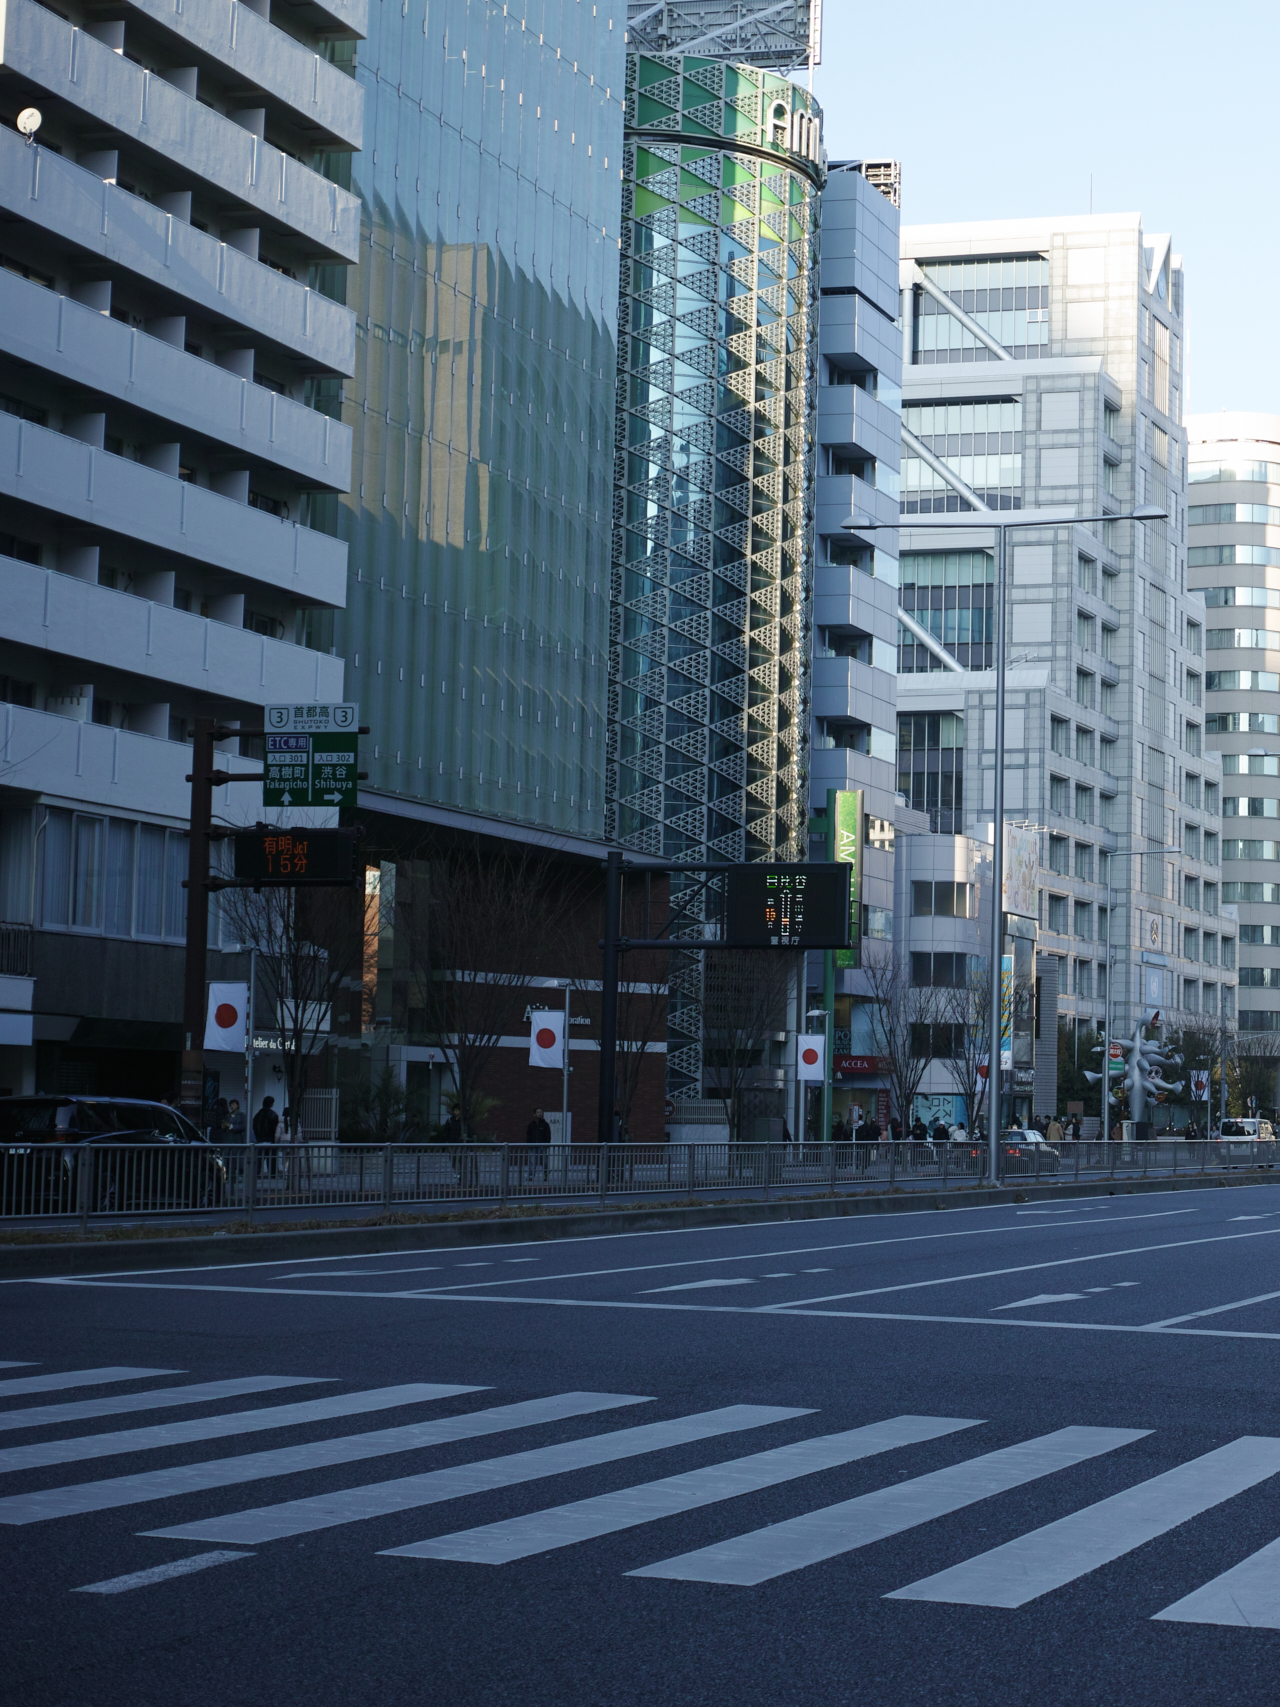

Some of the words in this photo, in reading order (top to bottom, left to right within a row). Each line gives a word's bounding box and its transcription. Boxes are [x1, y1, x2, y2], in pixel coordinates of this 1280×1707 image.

[276, 711, 283, 723] 3
[293, 706, 330, 718] 首都高
[340, 710, 348, 722] 3
[268, 737, 307, 749] ETC専用
[271, 755, 286, 763] 入口
[289, 755, 304, 763] 301
[318, 754, 333, 762] 入口
[336, 754, 351, 762] 302
[269, 766, 306, 779] 高樹町
[321, 766, 347, 779] 渋谷
[266, 779, 308, 790] Takagicho
[315, 779, 353, 790] Shibuya
[840, 1060, 868, 1068] ACCEA
